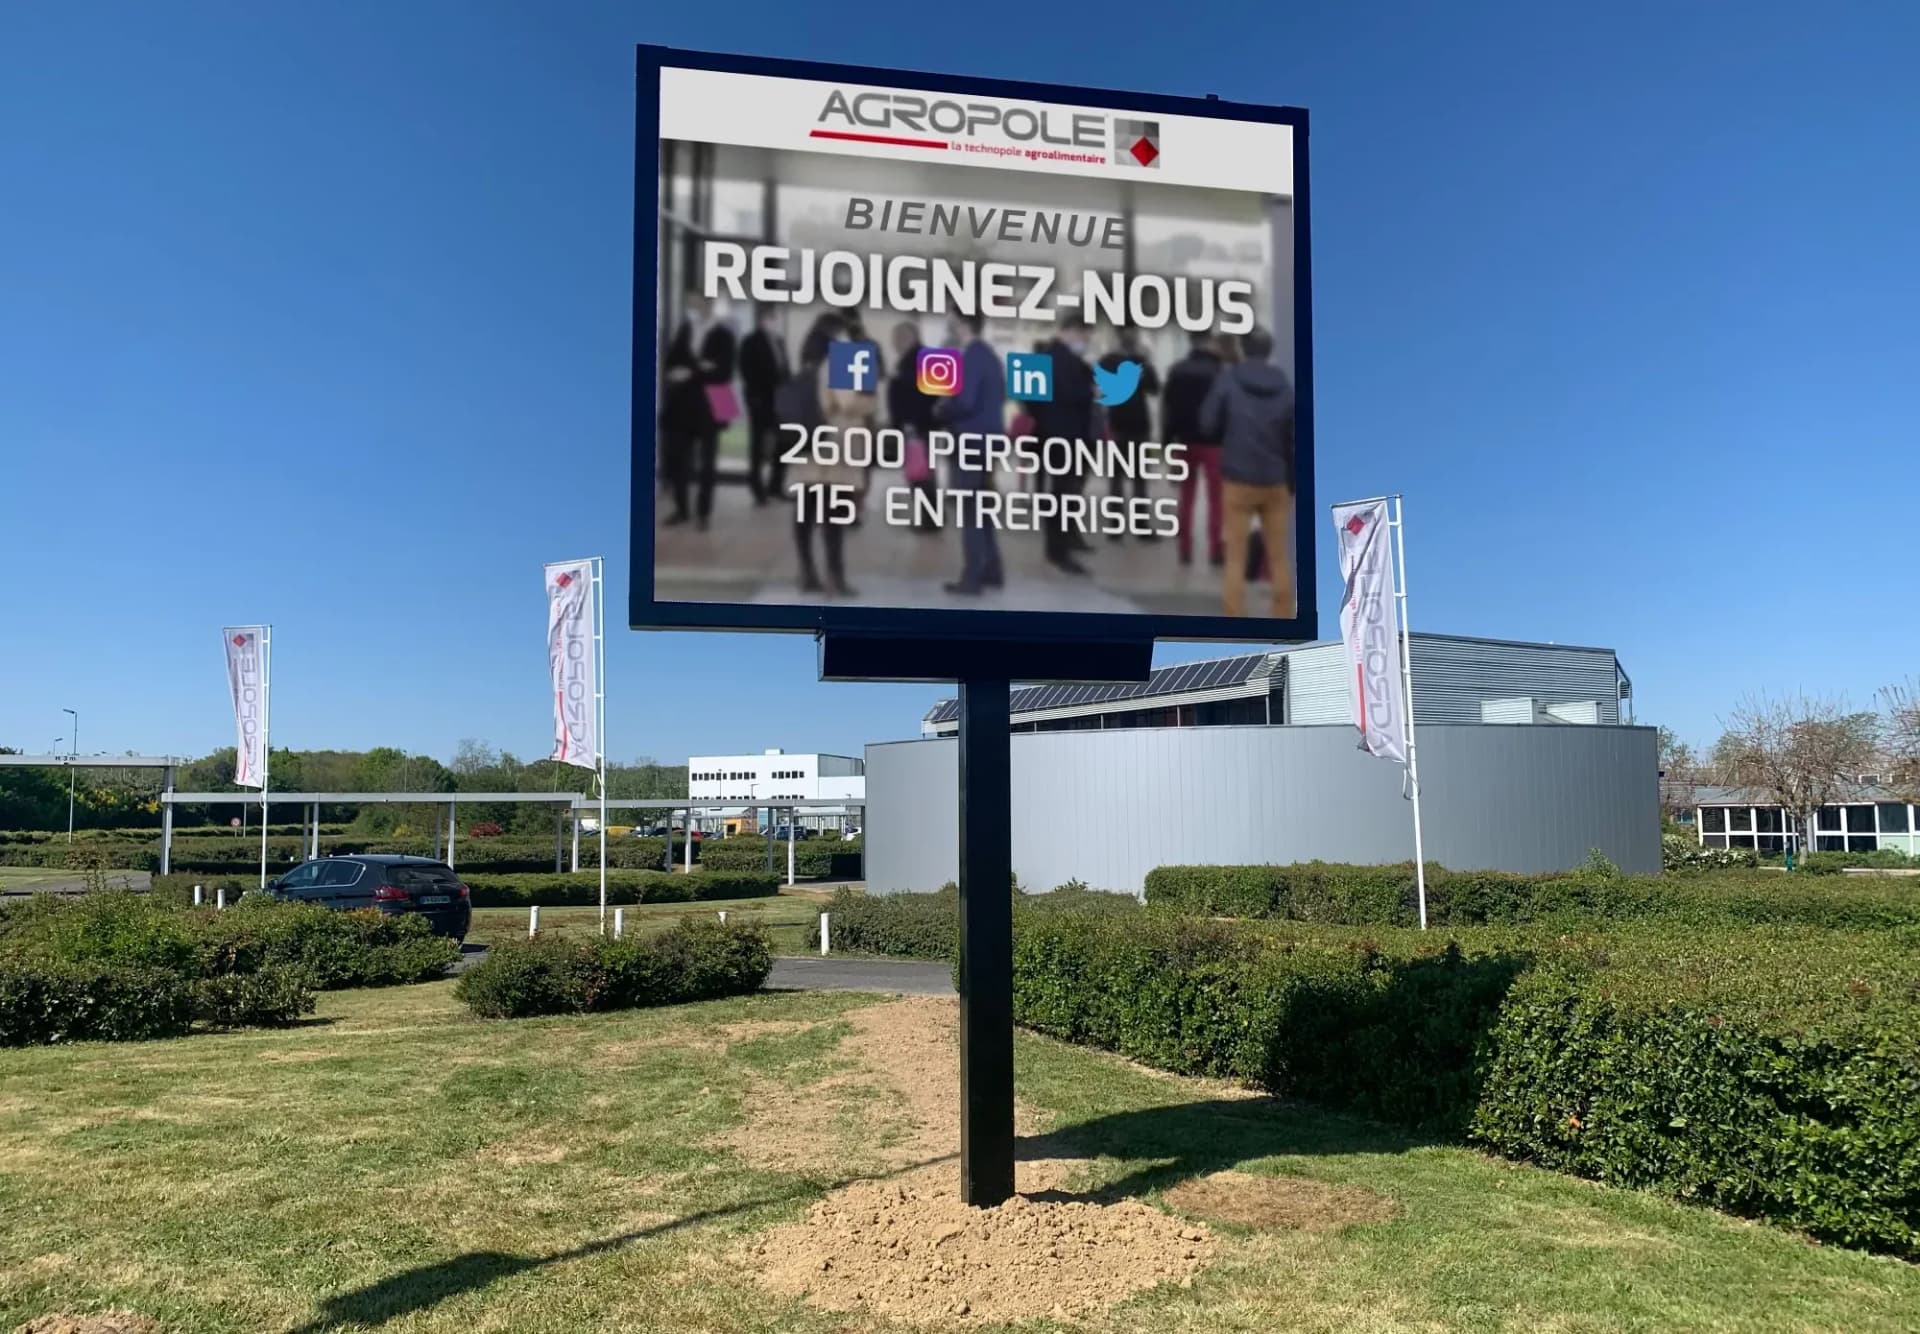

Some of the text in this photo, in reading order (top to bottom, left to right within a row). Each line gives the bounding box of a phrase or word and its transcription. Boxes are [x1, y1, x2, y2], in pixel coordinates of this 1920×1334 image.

[818, 90, 1105, 148] AGROPOLE
[951, 142, 1105, 164] la technopole agroalimentaire
[844, 197, 1128, 251] BIENVENUE
[703, 241, 1255, 335] REJOIGNEZ-NOUS
[1012, 359, 1047, 395] in
[779, 424, 1189, 482] 2600 PERSONNES
[788, 483, 1179, 537] 115 ENTREPRISES
